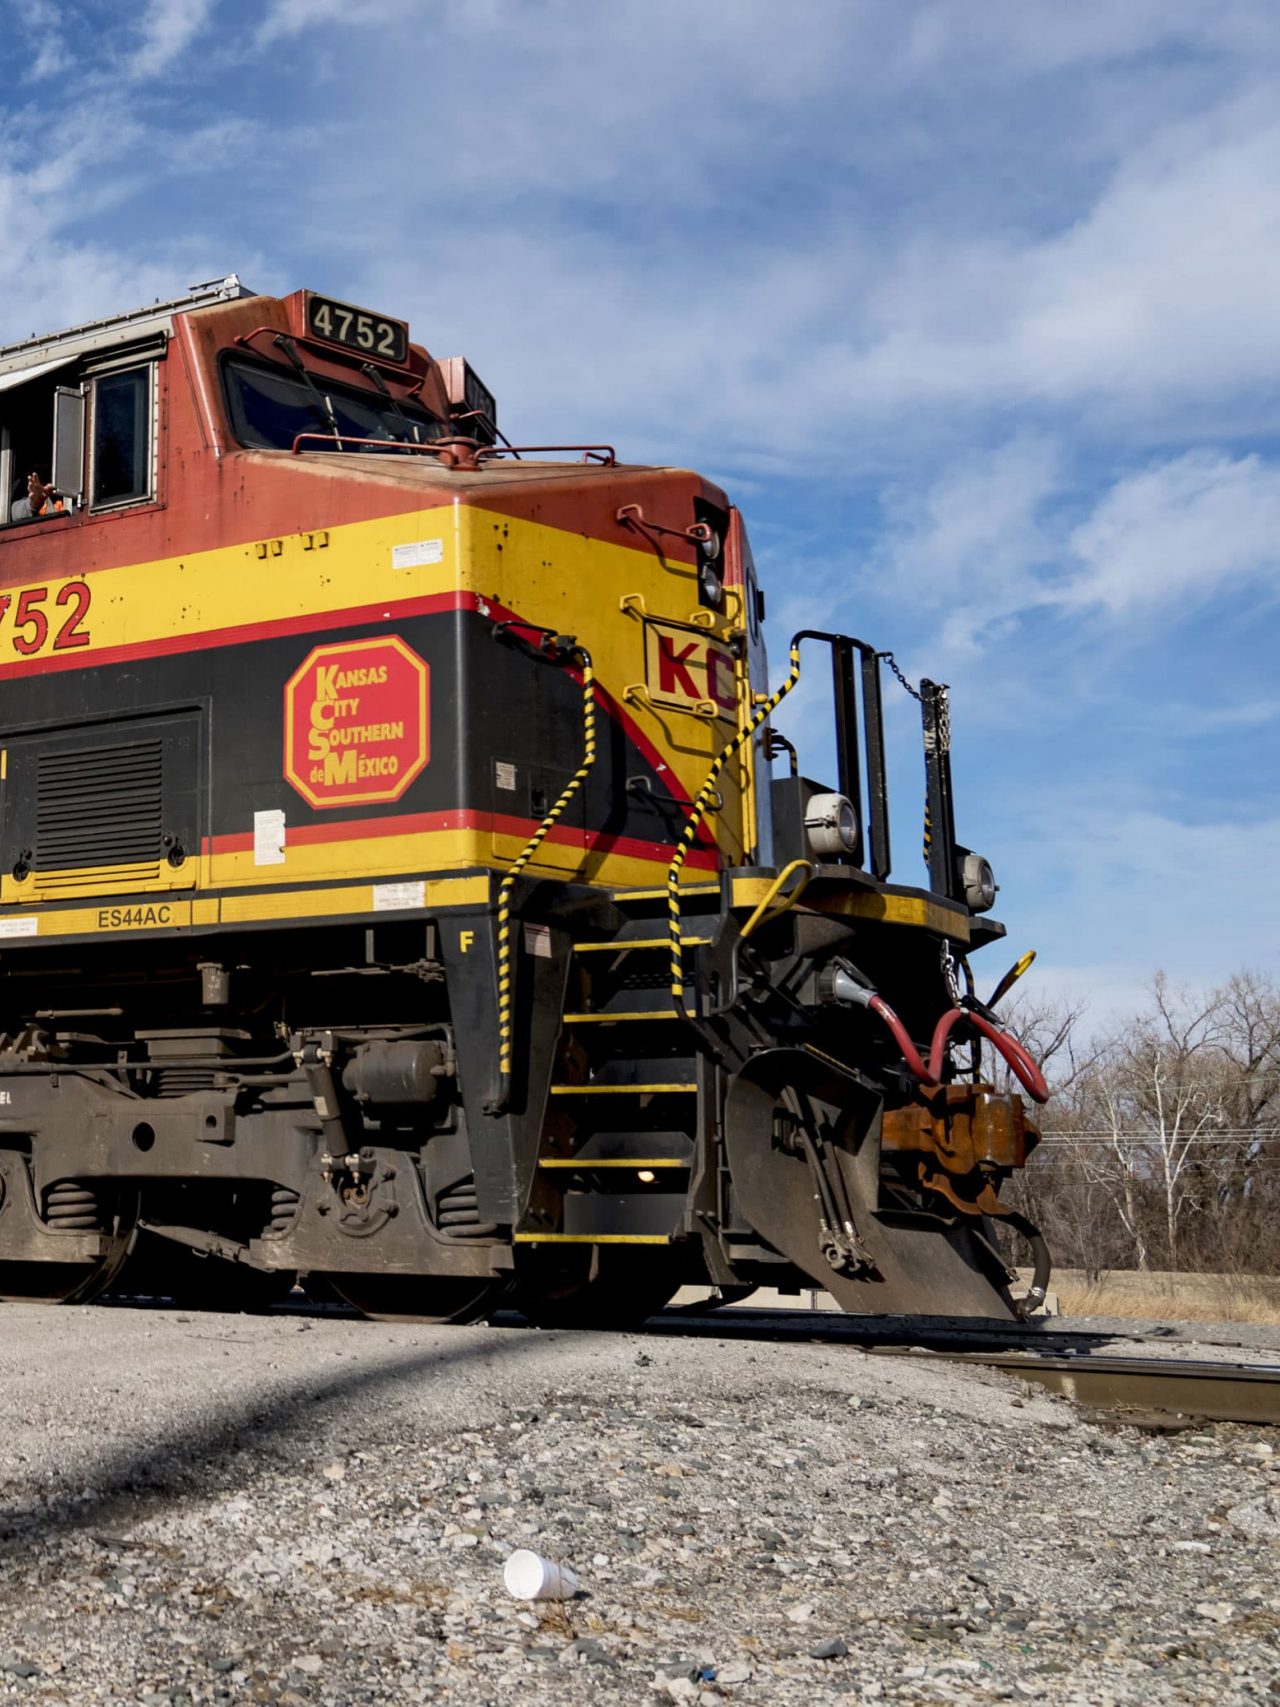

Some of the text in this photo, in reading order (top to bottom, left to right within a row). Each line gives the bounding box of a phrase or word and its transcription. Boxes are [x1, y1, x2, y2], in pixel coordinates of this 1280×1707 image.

[313, 304, 395, 356] 4752
[316, 664, 388, 701] KANSAS
[310, 698, 360, 730] CITY
[308, 721, 404, 760] SOUTHERN
[98, 905, 170, 928] ES44AC
[460, 930, 474, 953] F
